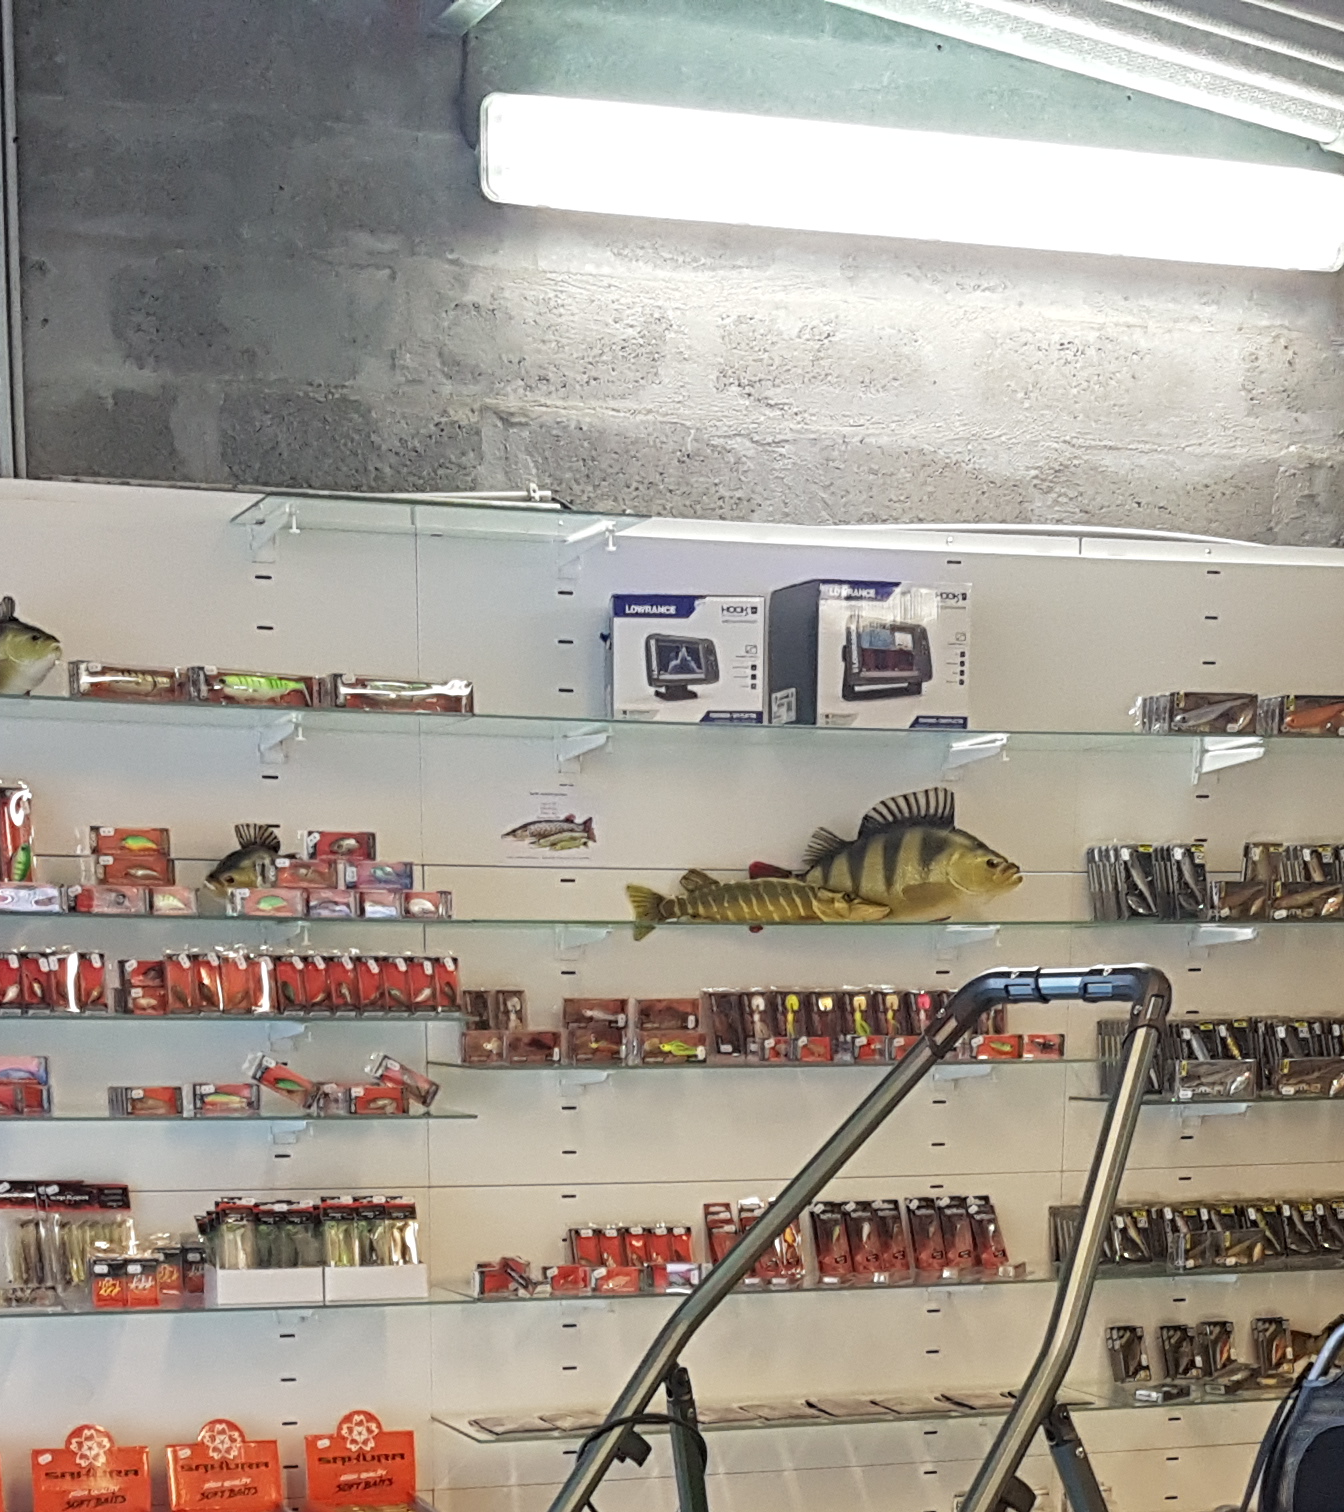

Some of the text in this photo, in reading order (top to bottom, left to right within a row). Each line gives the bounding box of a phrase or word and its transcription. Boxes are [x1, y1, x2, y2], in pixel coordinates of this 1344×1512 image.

[625, 604, 677, 614] LOWRANCE
[317, 1452, 406, 1466] SAKURA
[180, 1460, 270, 1473] SAKURA
